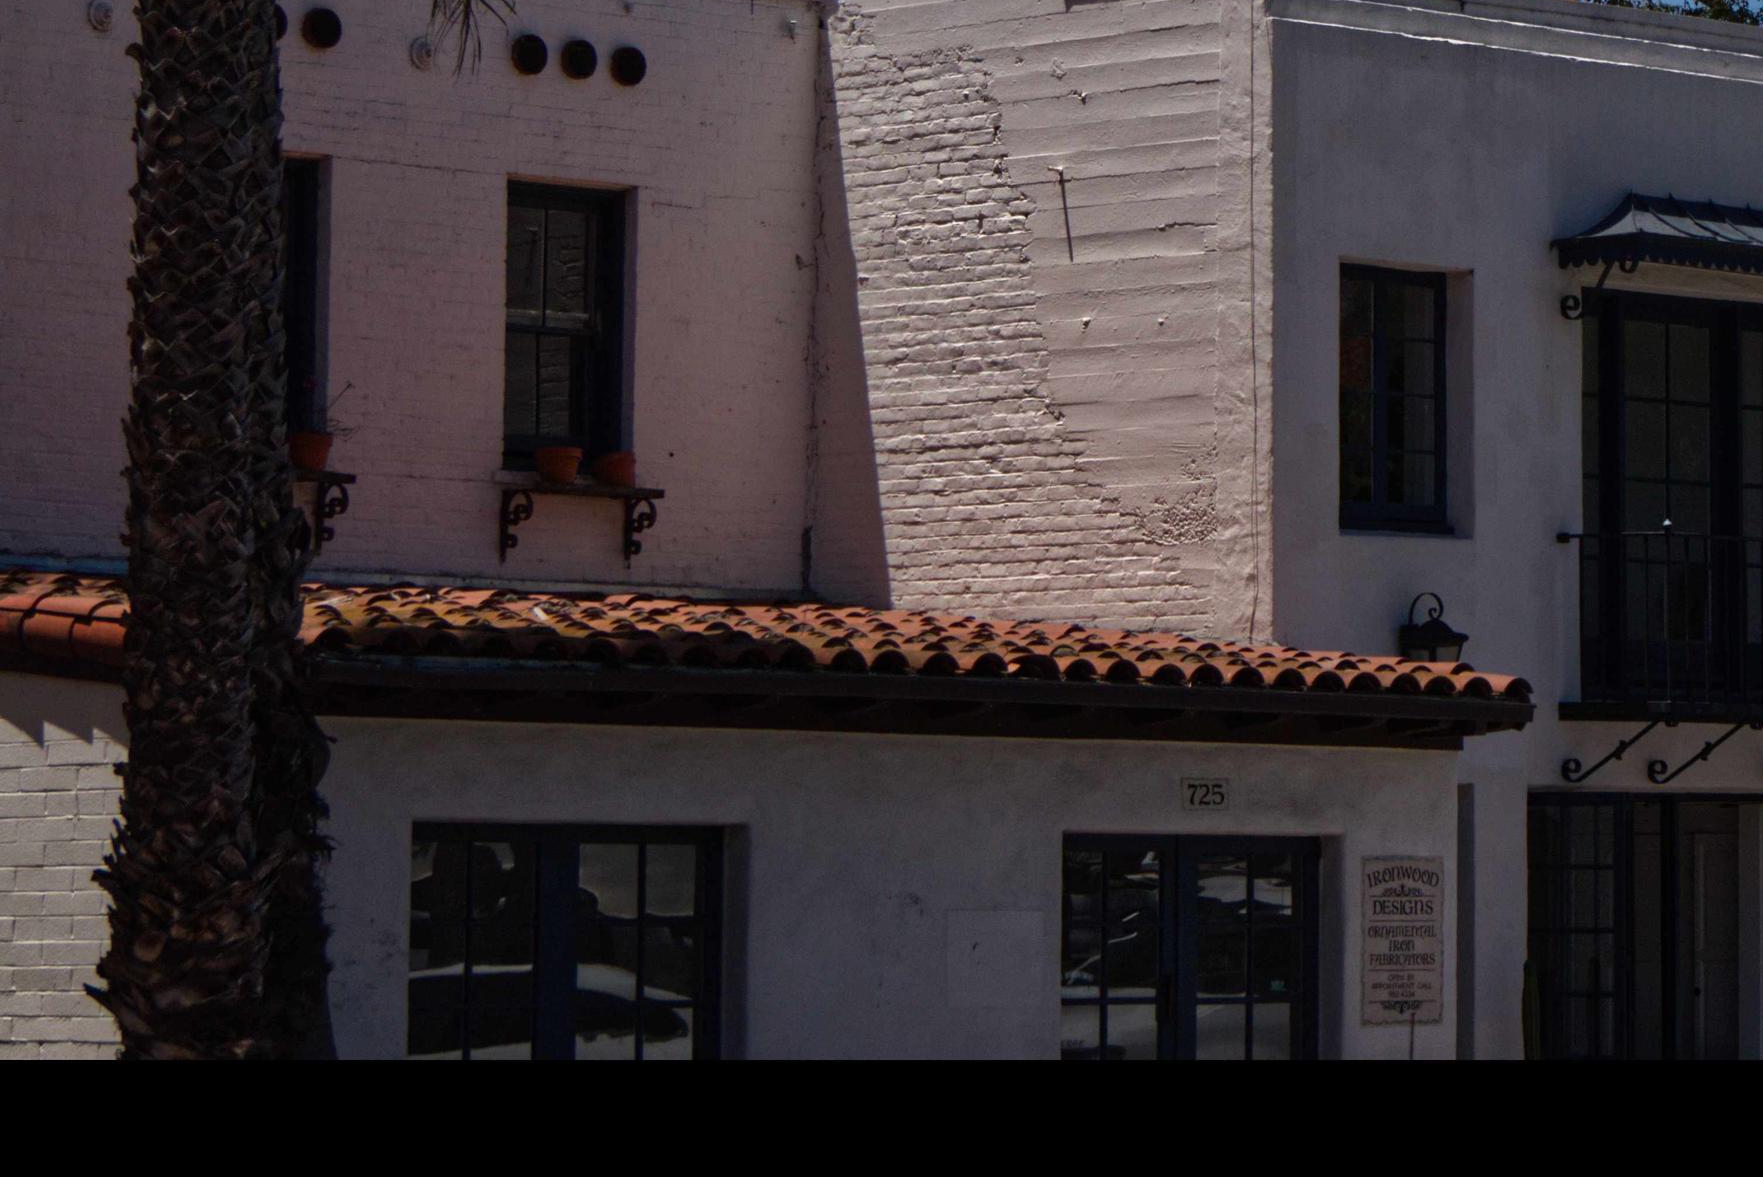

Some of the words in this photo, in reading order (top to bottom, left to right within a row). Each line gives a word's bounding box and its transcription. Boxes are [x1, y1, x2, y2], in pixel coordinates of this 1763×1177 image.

[1187, 783, 1225, 806] 725
[1366, 865, 1440, 889] IRONWOOD
[1372, 899, 1434, 916] DESIGNS
[1368, 925, 1437, 938] ORNAMENTAL
[1389, 939, 1415, 952] IRON
[1369, 953, 1436, 966] FABRICATORS
[1371, 982, 1415, 990] APPOINTMENT
